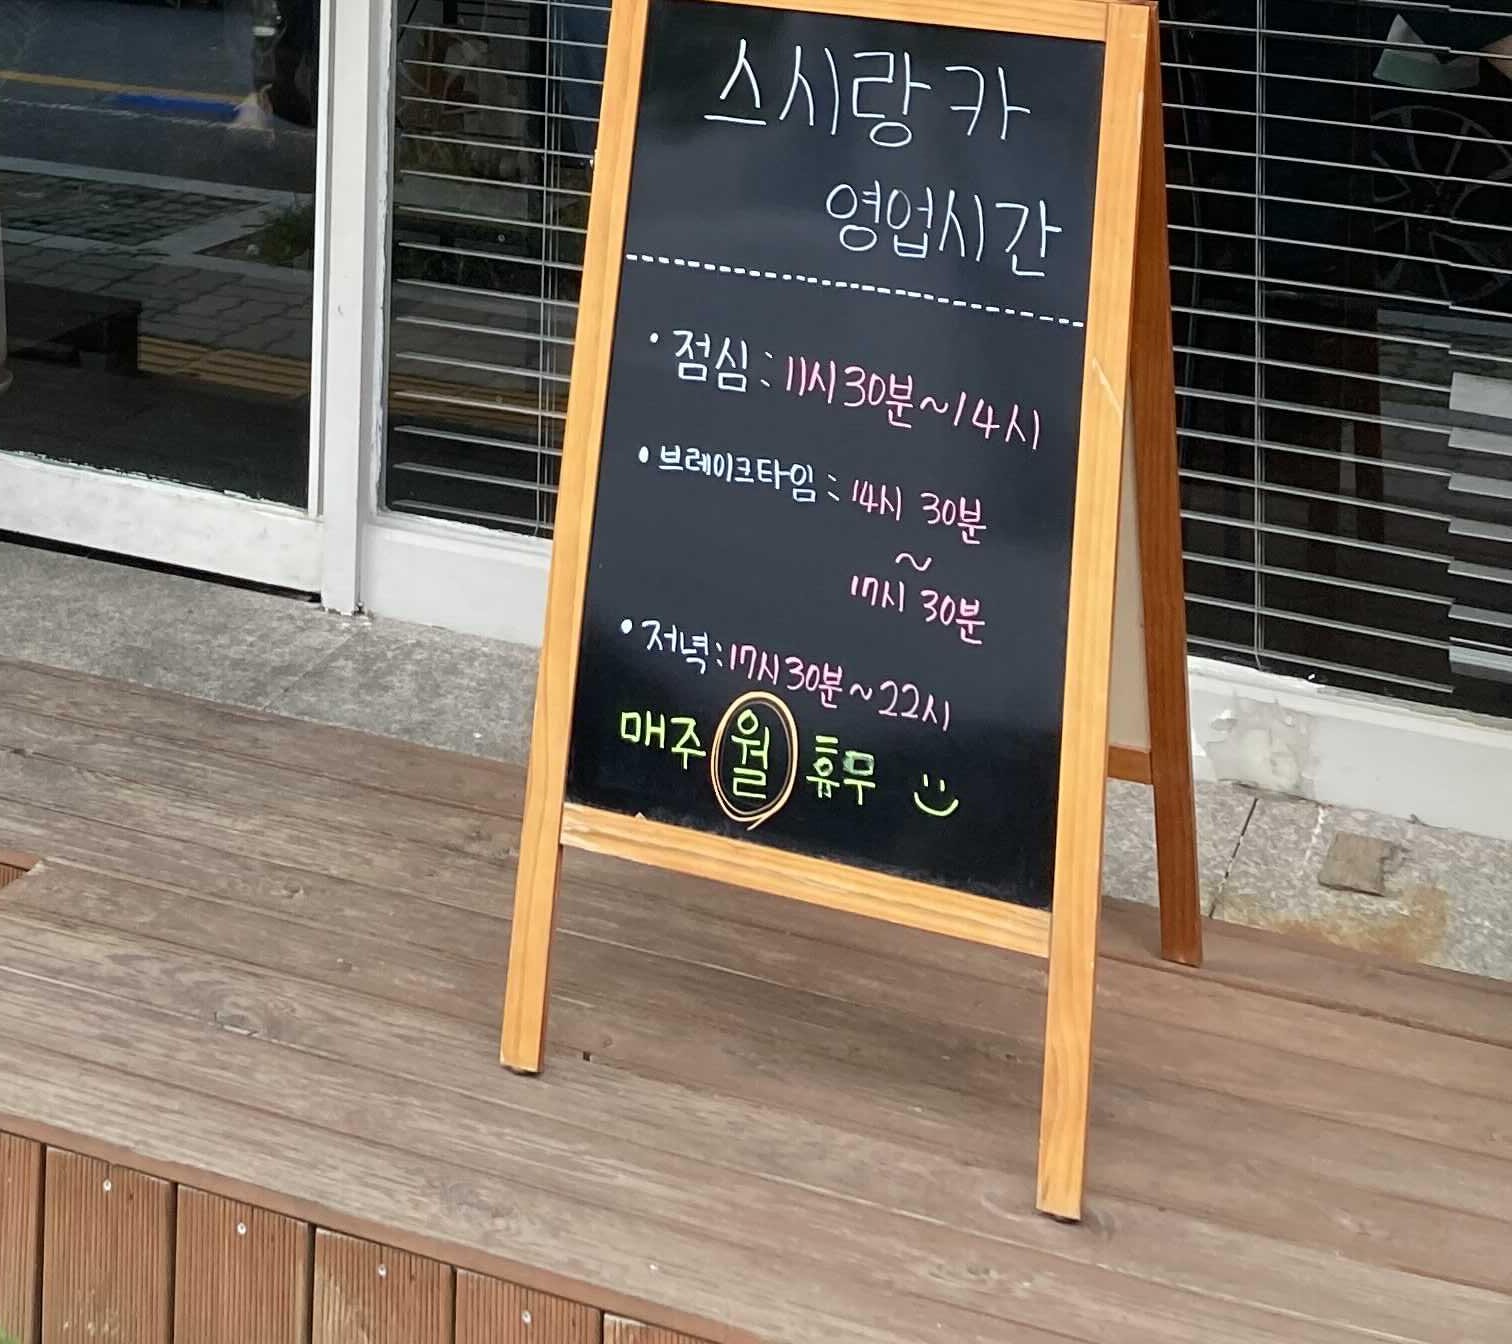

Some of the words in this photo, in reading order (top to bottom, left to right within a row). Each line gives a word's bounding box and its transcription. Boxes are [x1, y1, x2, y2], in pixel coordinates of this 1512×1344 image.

[825, 179, 1064, 278] 영업시간
[921, 491, 988, 545] 30분
[920, 588, 987, 645] 30분
[620, 709, 707, 769] 매주
[730, 708, 769, 800] 월
[806, 734, 877, 806] 휴무
